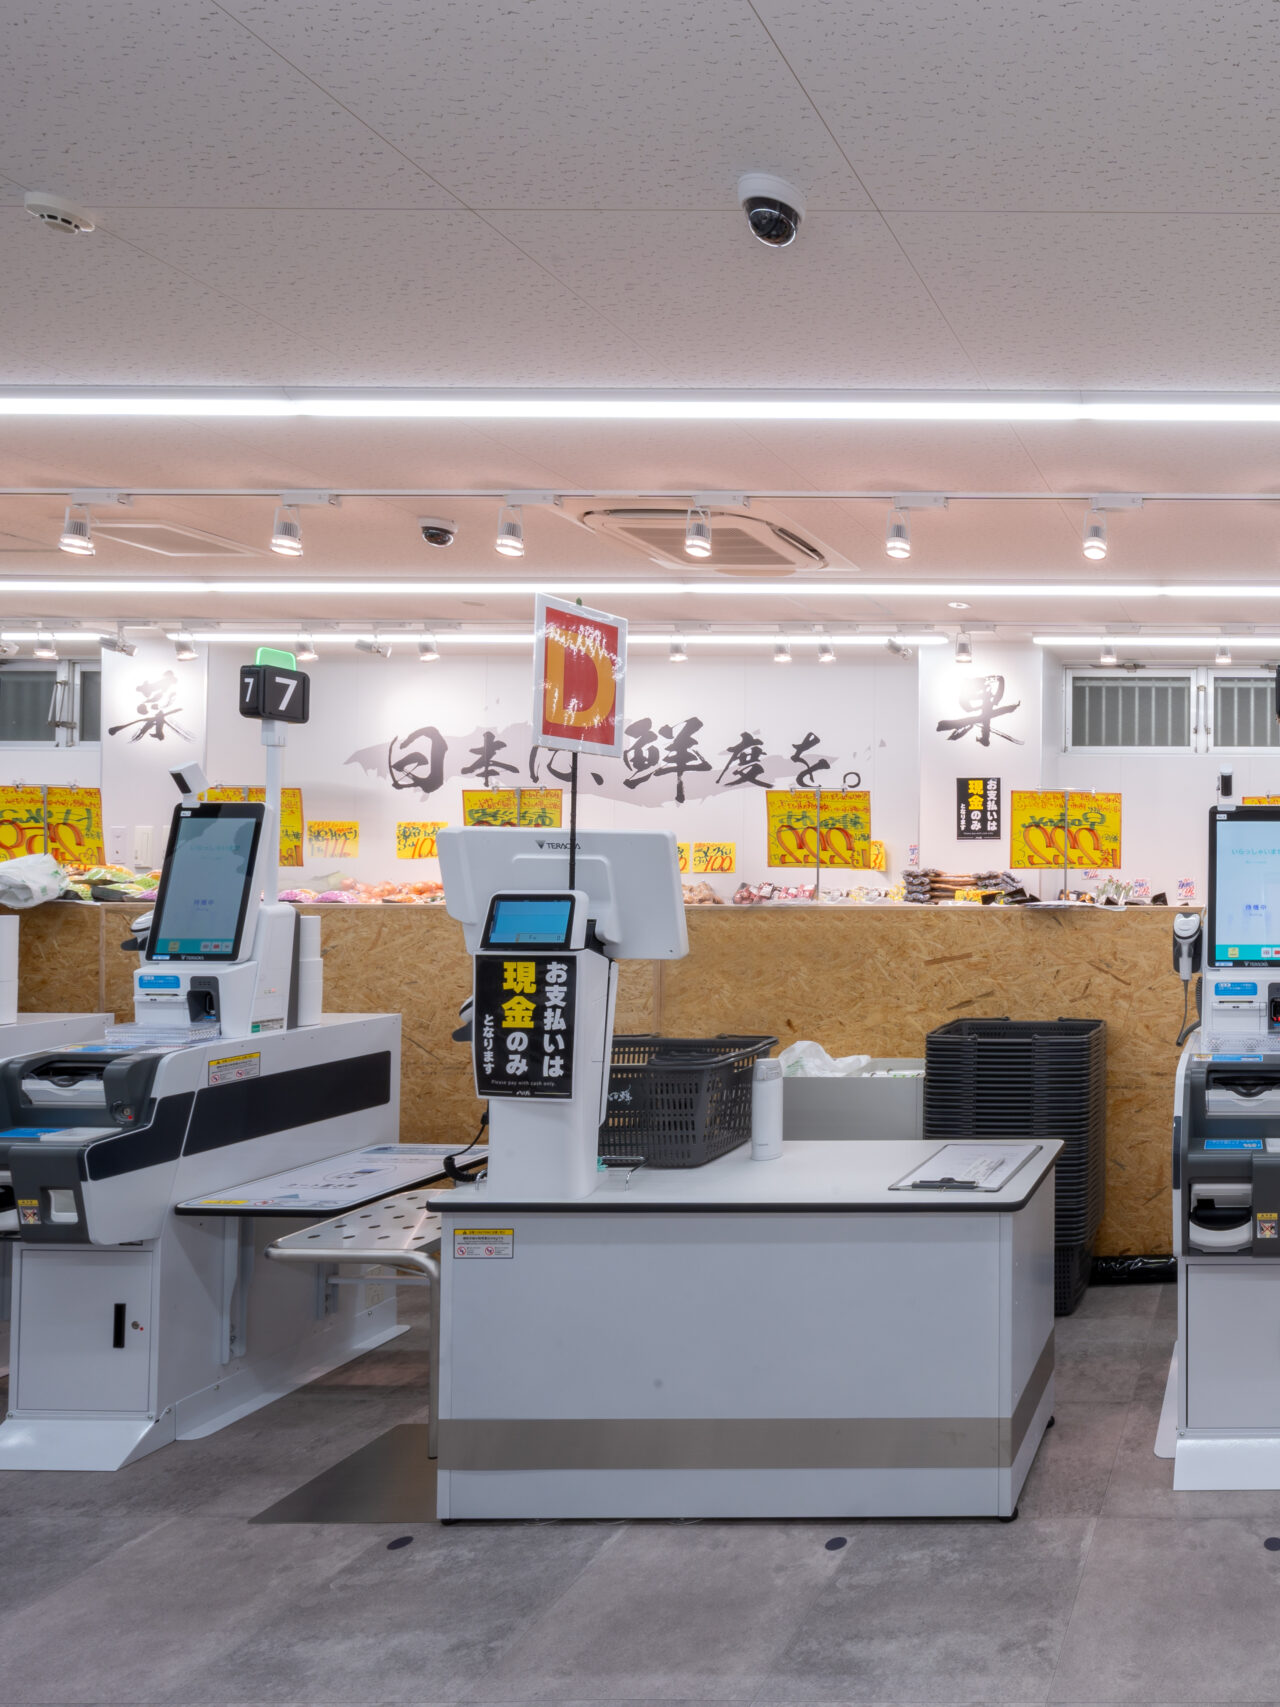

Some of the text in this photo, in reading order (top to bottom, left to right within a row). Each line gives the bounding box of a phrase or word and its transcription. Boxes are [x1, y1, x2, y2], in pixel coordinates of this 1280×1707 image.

[243, 677, 254, 702] 7
[274, 676, 298, 711] 7
[545, 626, 615, 728] D
[936, 674, 1025, 748] 果
[968, 779, 984, 831] 現金のみ
[986, 778, 998, 831] お支払いは
[546, 842, 581, 850] TERAOA
[482, 1013, 496, 1075] となります
[501, 960, 537, 1077] 現金のみ
[542, 961, 568, 1078] お支払いは
